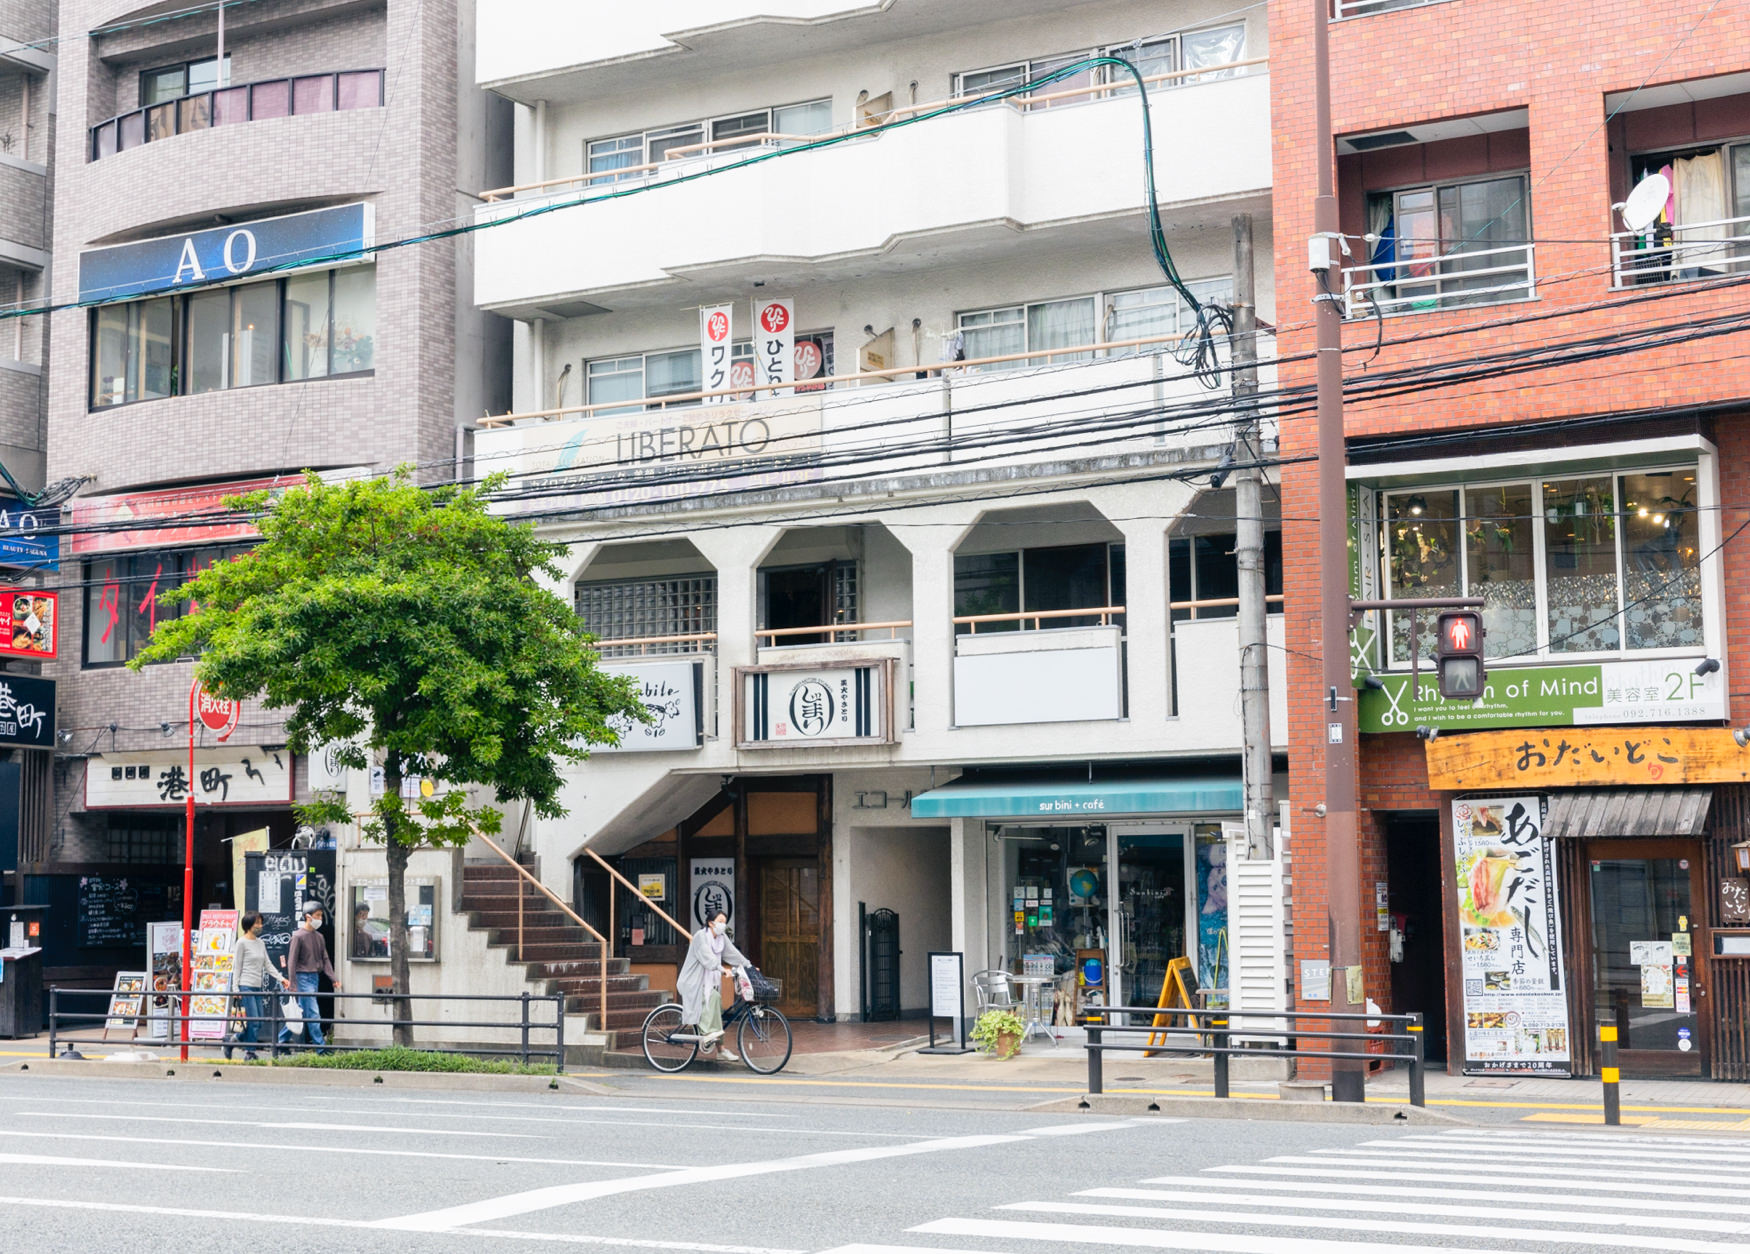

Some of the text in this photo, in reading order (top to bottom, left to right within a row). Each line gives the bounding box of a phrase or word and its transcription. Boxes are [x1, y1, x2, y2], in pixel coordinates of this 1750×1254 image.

[172, 229, 257, 284] AO
[617, 418, 770, 467] LIBERATO
[1505, 680, 1530, 698] of
[1540, 677, 1598, 697] Mind
[1607, 672, 1704, 703] 美容室 2F
[1435, 705, 1447, 713] you
[1473, 711, 1513, 720] comfortable
[1515, 710, 1538, 719] rhythm
[1515, 738, 1679, 771] おだいどこ
[157, 765, 233, 802] 港町
[1082, 798, 1105, 810] café
[1500, 802, 1541, 958] あごだし
